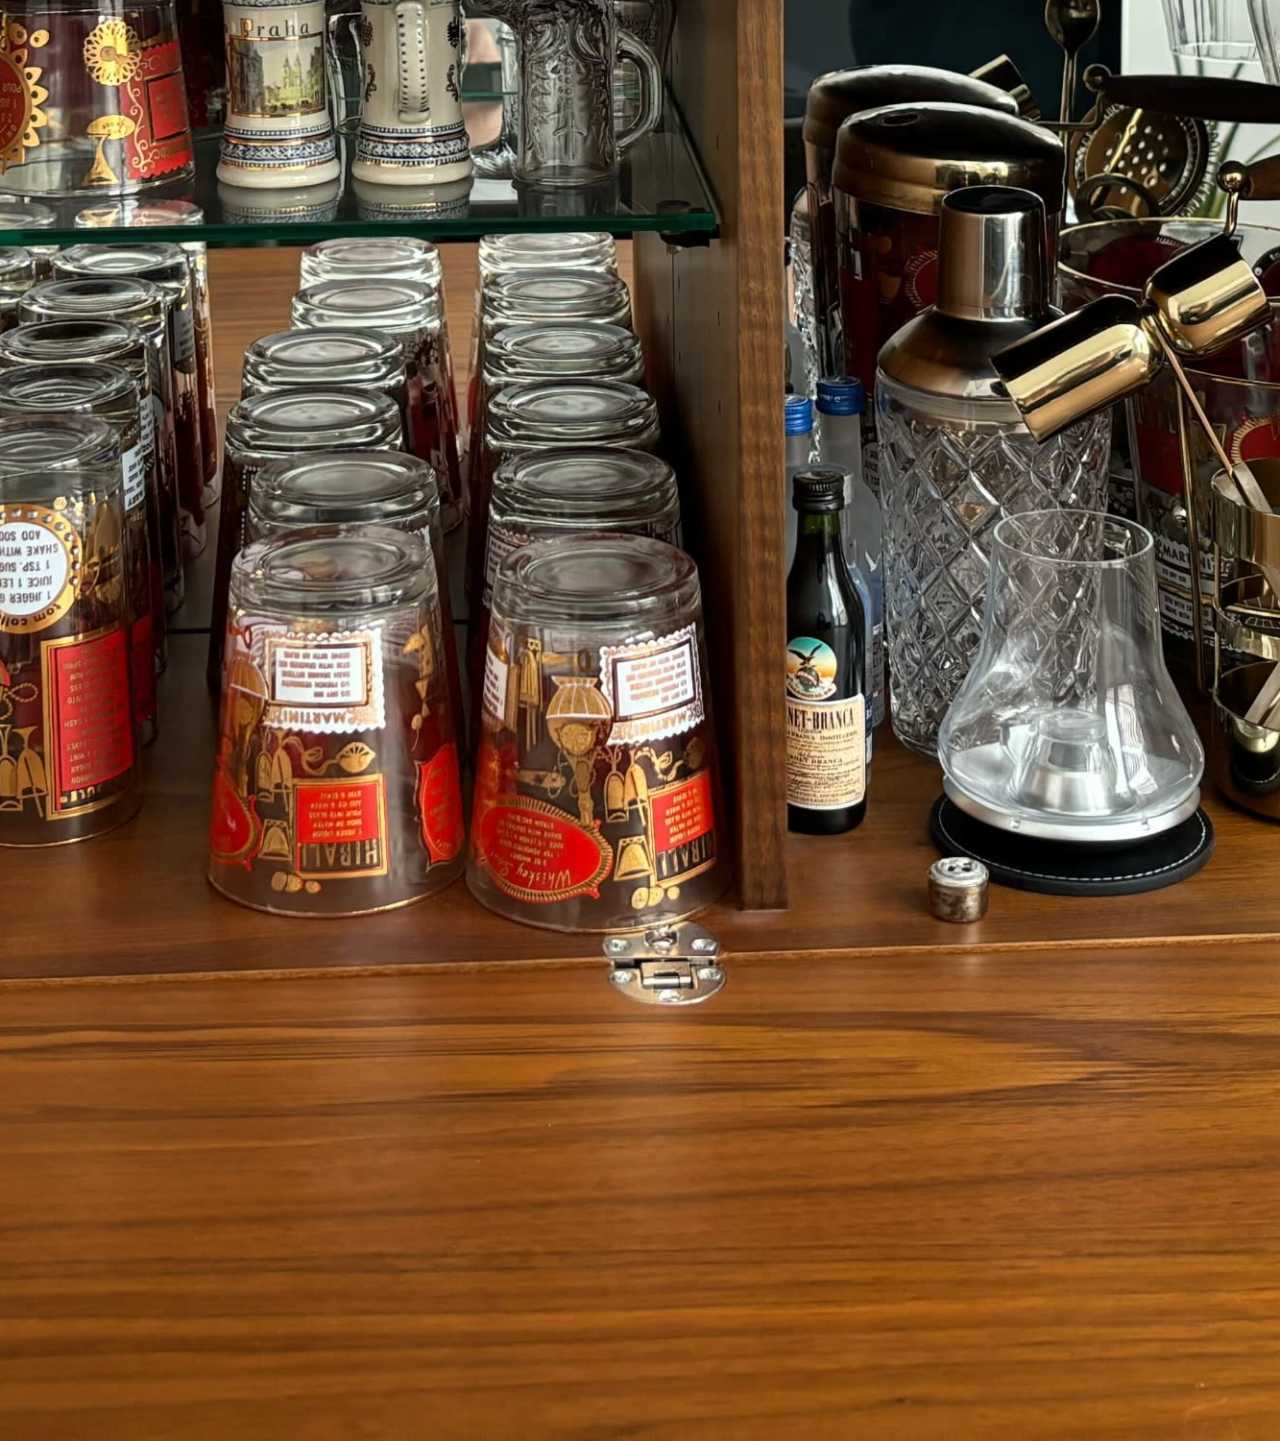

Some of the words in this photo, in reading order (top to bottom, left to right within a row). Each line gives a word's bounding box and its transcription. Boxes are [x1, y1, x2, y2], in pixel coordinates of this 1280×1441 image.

[240, 17, 310, 38] Praha
[21, 531, 40, 540] ADD
[26, 544, 58, 556] SHAKE
[20, 561, 40, 571] TSP.
[28, 576, 52, 588] JUICE
[9, 592, 42, 603] JIGGER
[32, 604, 61, 623] tom
[283, 711, 346, 724] MARTINI
[787, 708, 854, 730] NET-BRANCA
[516, 863, 571, 889] Whiskey
